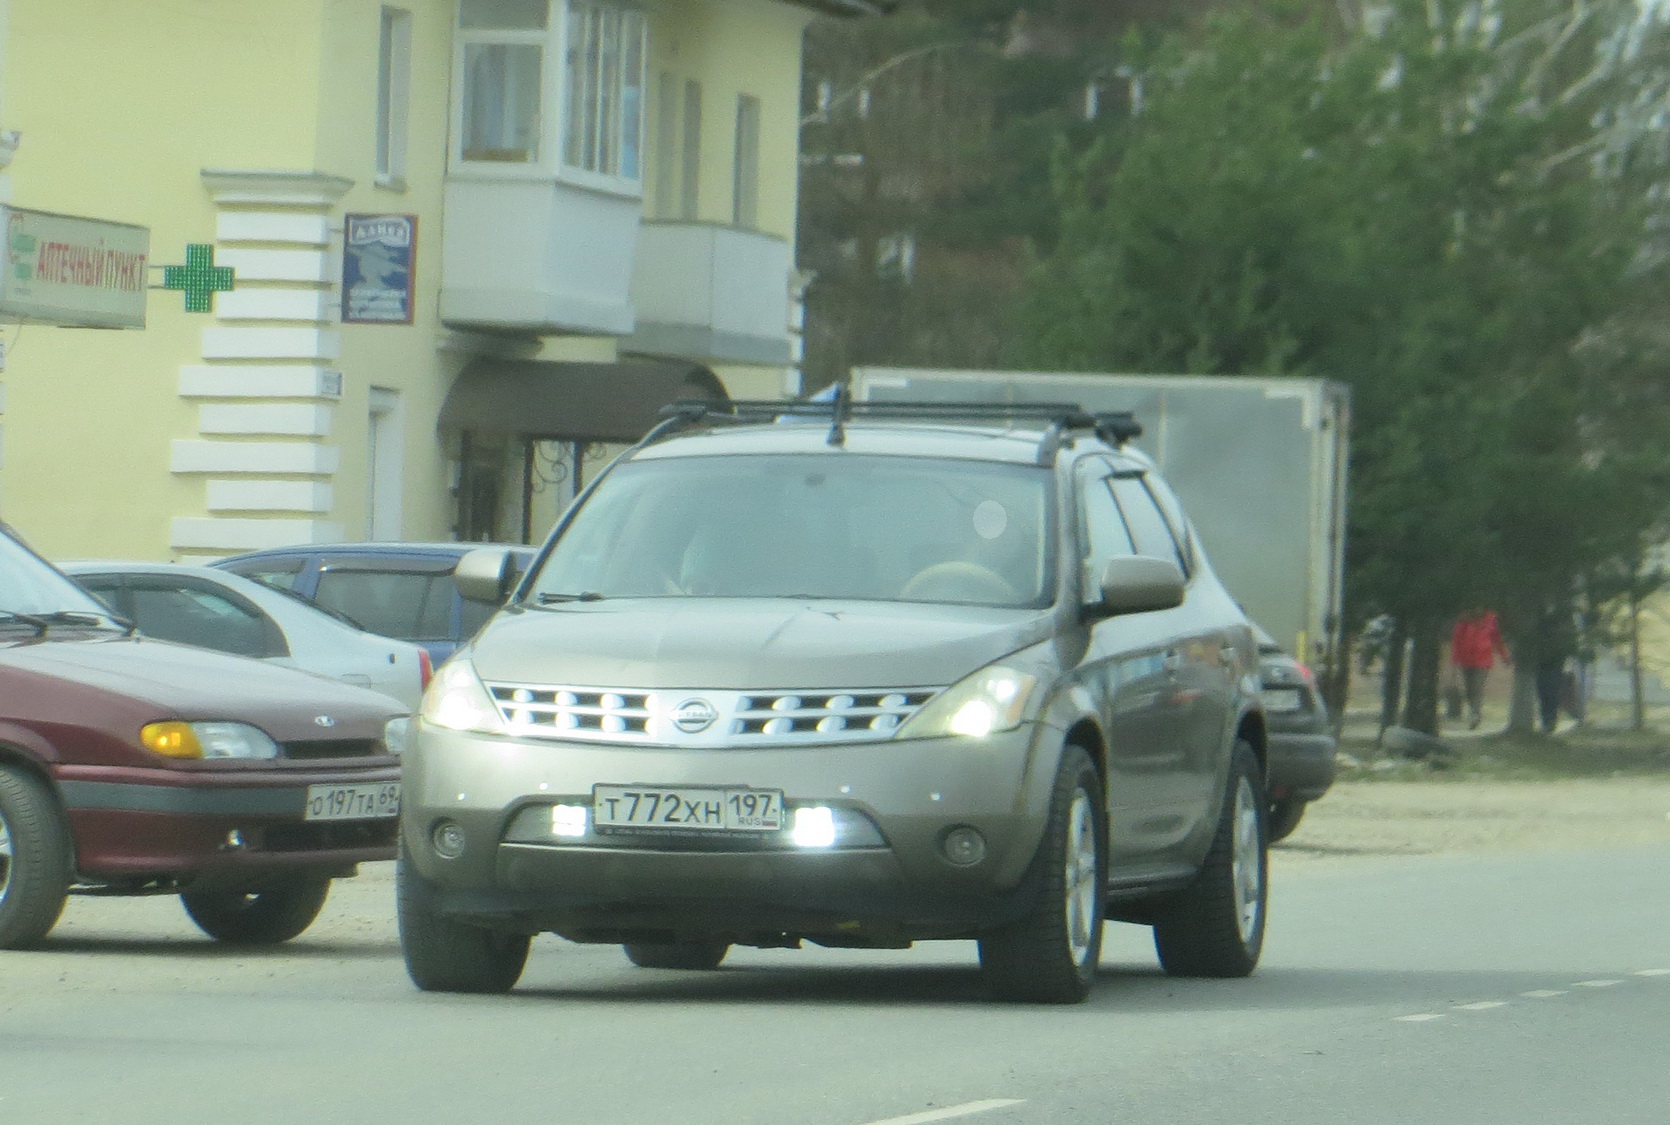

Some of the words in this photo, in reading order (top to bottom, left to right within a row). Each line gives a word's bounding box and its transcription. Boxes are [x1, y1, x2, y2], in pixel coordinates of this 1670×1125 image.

[37, 238, 104, 287] АПТЕЧНЫЙ
[105, 250, 146, 291] ПУНКТ
[729, 794, 772, 817] 197
[738, 817, 761, 827] RUS
